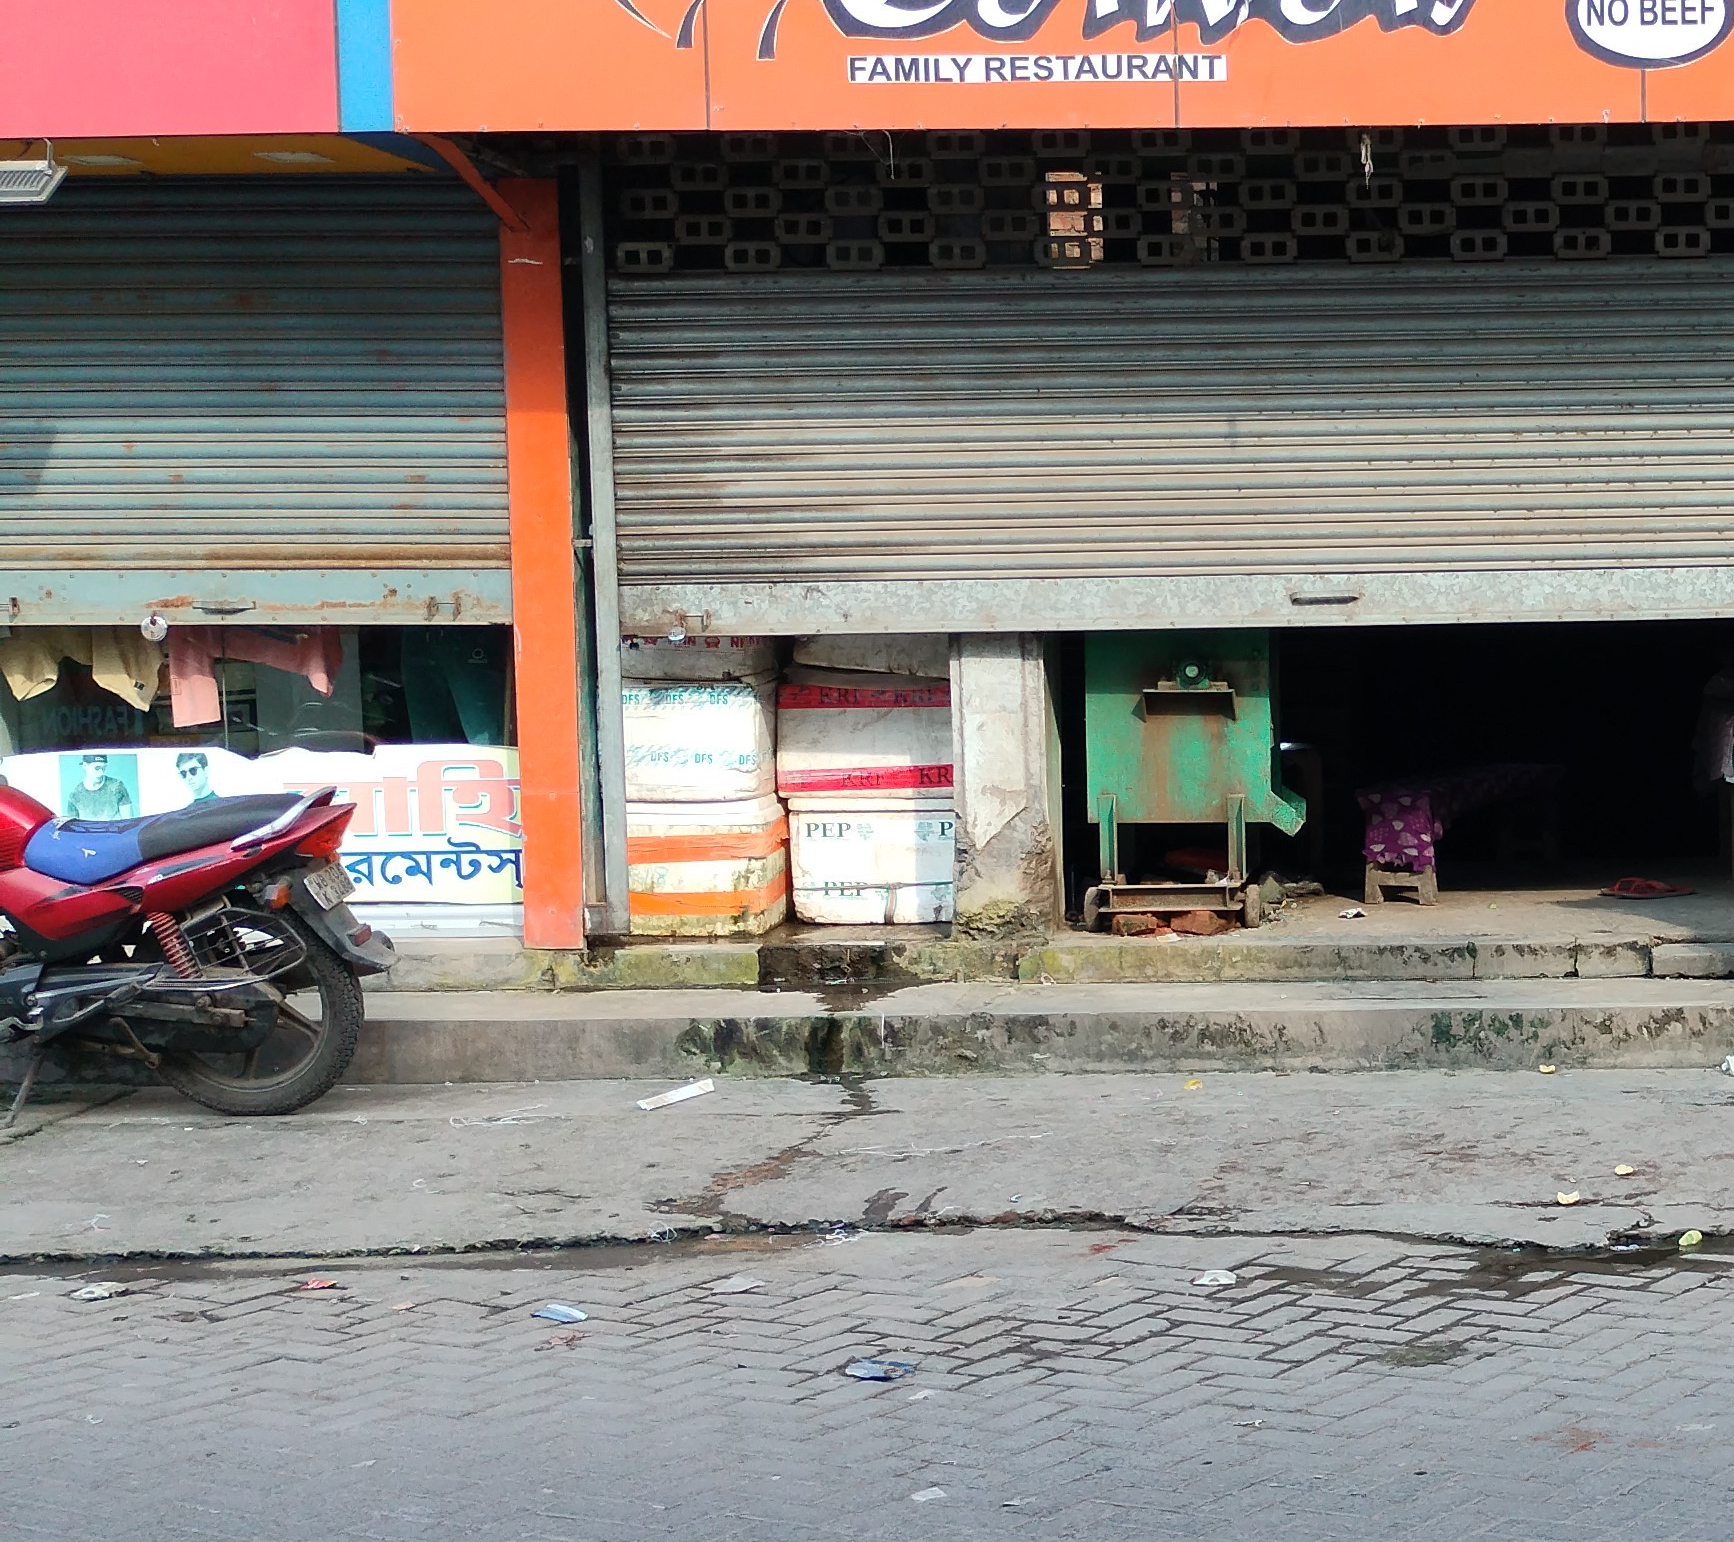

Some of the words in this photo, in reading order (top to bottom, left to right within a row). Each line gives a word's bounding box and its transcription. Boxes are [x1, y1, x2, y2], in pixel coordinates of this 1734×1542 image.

[848, 56, 977, 84] FAMILY
[985, 54, 1223, 83] RESTAURANT
[709, 694, 728, 705] DFS
[694, 753, 713, 764] DFS
[805, 822, 852, 838] PEP
